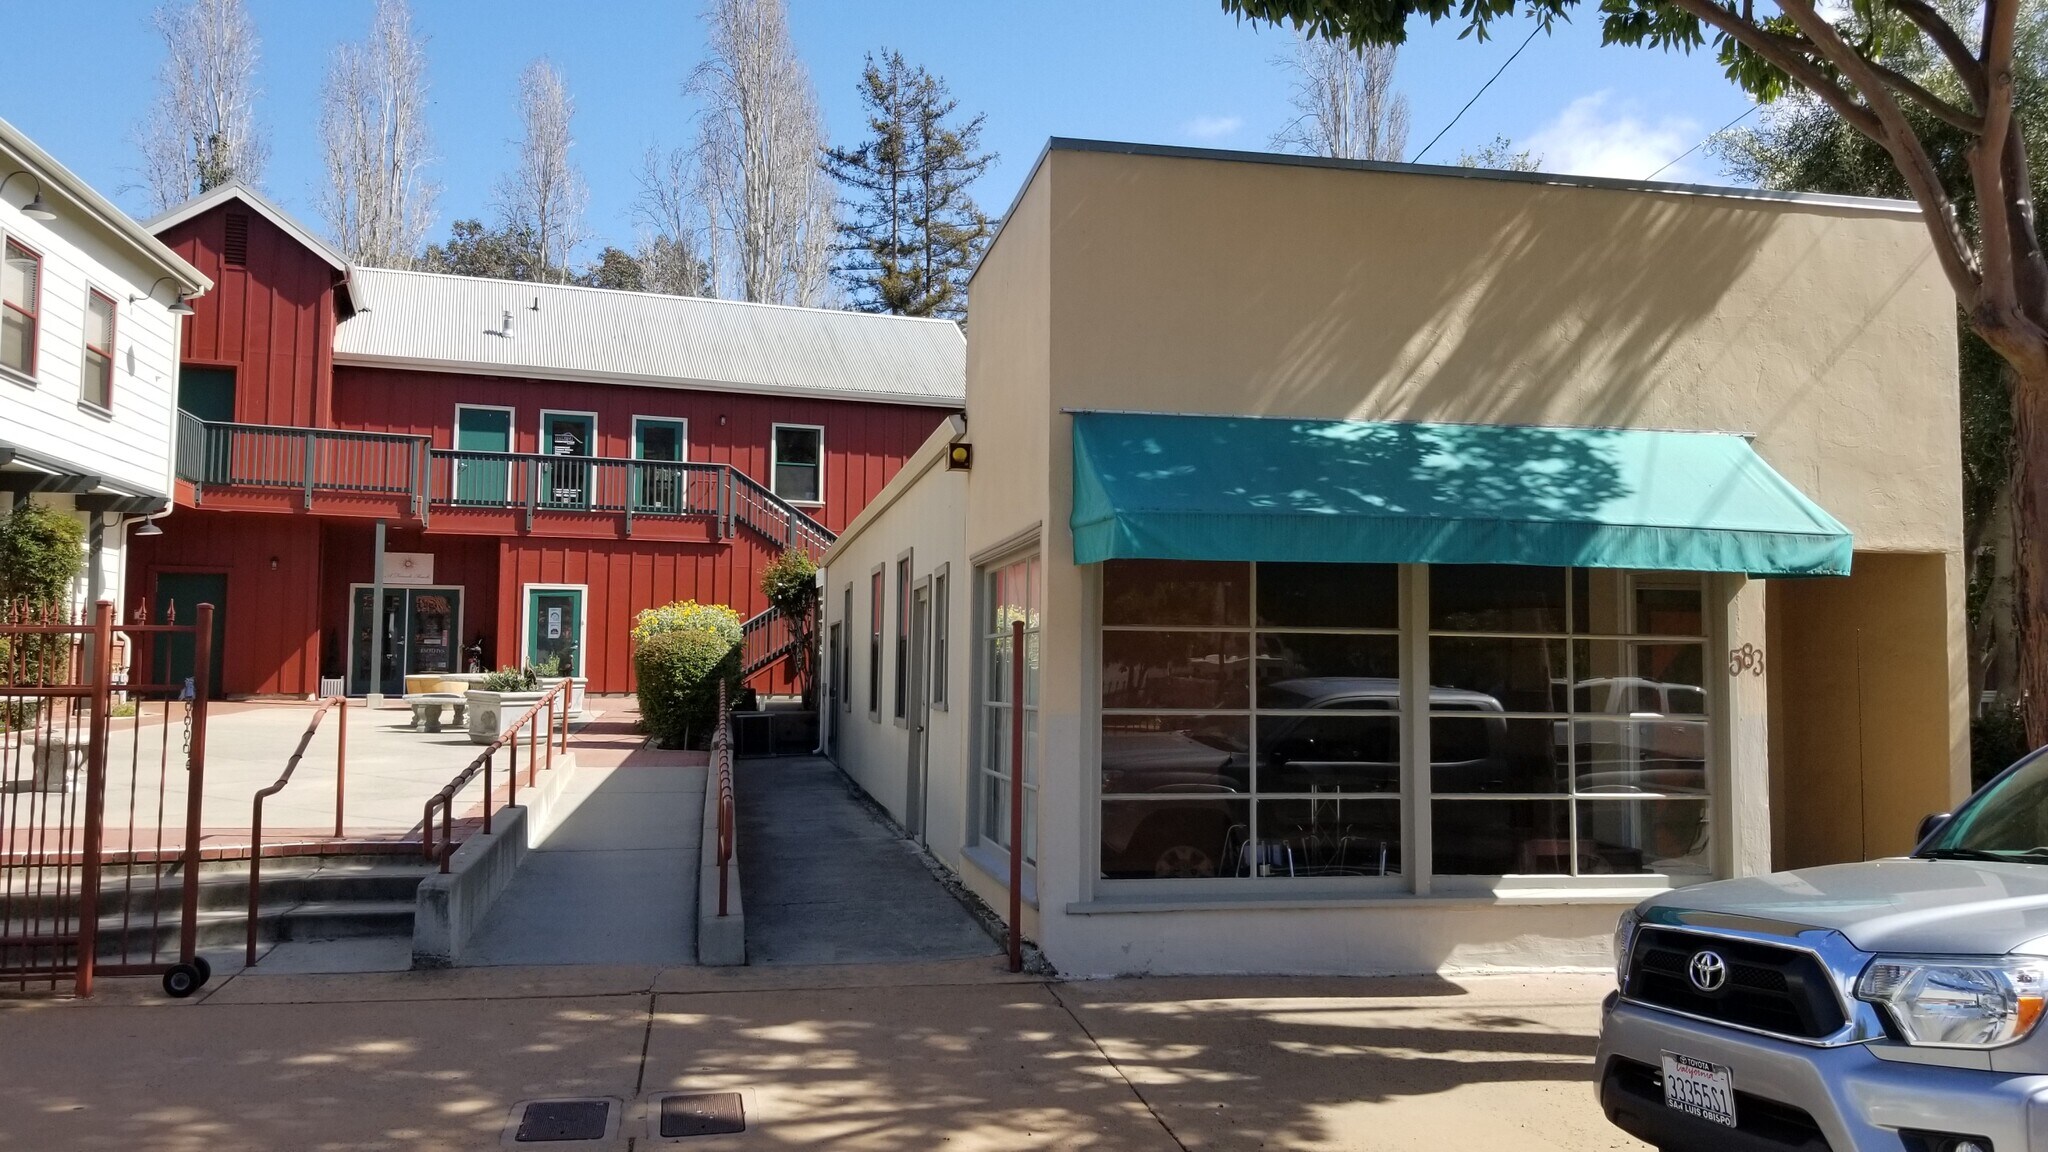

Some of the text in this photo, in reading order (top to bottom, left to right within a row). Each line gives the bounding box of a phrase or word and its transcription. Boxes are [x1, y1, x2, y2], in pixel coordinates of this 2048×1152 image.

[1729, 643, 1764, 677] 583
[1676, 1063, 1718, 1082] California
[1687, 1058, 1710, 1070] TOYOTA
[1685, 1104, 1702, 1117] LUIS
[1703, 1110, 1731, 1126] OBISPO
